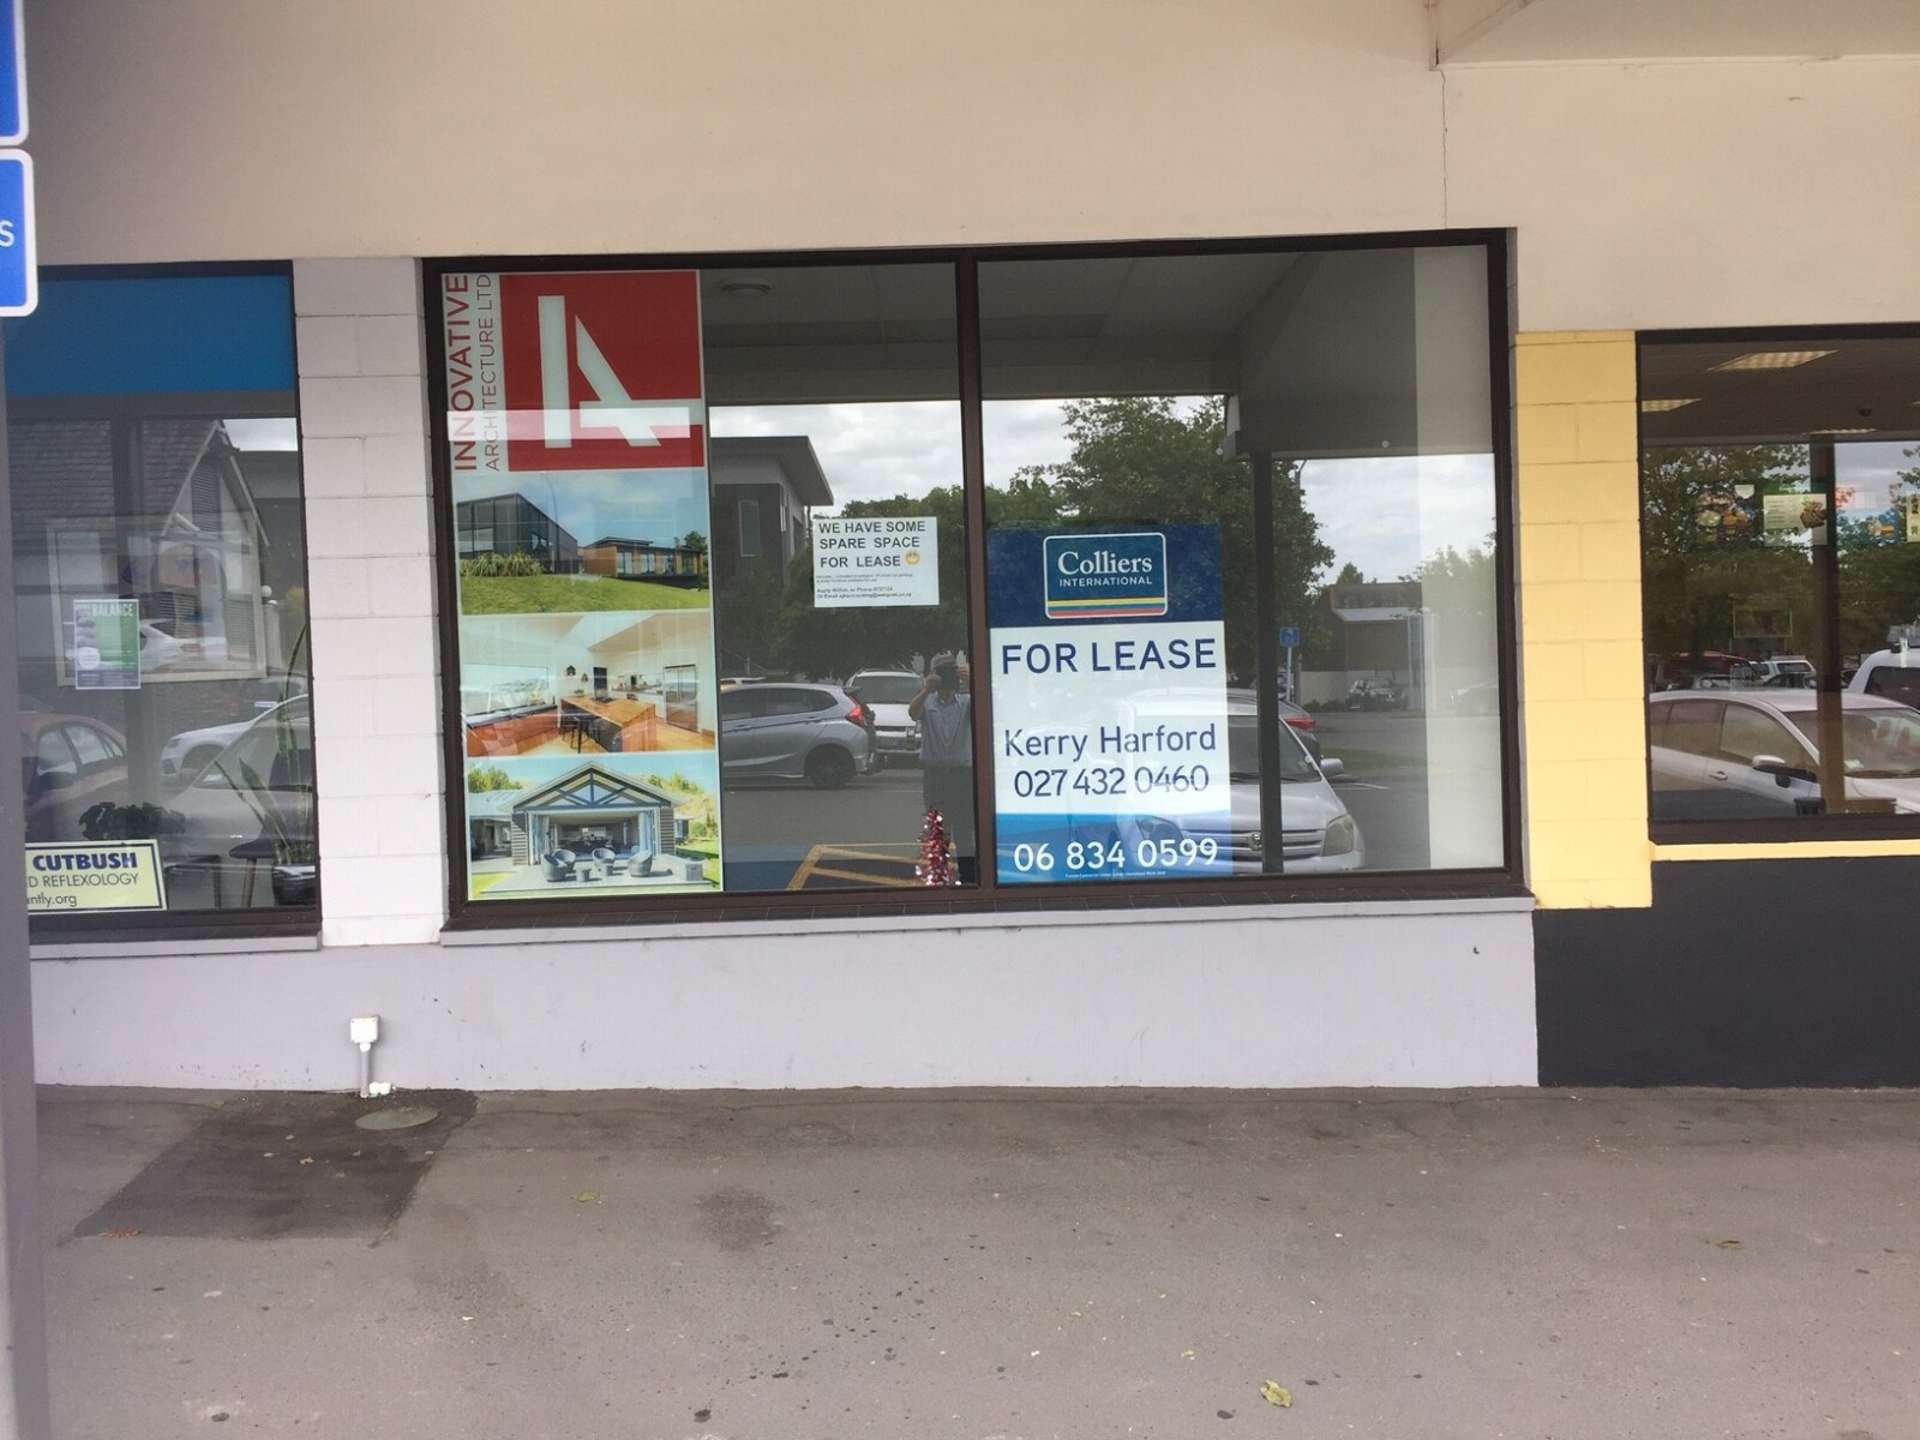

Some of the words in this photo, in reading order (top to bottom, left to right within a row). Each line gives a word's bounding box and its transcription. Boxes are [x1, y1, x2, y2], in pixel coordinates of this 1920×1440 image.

[476, 274, 493, 311] LTD
[445, 275, 477, 471] INNOVATIVE
[478, 317, 500, 472] ARCHITECTURE
[819, 522, 840, 534] WE
[845, 521, 882, 533] HAVE
[886, 520, 926, 532] SOME
[820, 538, 866, 549] SPARE
[874, 536, 920, 548] SPACE
[820, 557, 848, 568] FOR
[856, 555, 901, 567] LEASE
[1057, 550, 1152, 576] Colliers
[1059, 576, 1152, 587] INTERNATIONAL
[1002, 642, 1078, 674] FOR
[1092, 638, 1216, 672] LEASE
[1006, 729, 1088, 762] Kerry
[1100, 723, 1216, 753] Harford
[1014, 769, 1068, 798] 027
[1073, 767, 1127, 795] 432
[1134, 765, 1210, 793] 0460
[32, 852, 138, 871] CUTBUSH
[1014, 843, 1055, 872] 06
[1066, 841, 1126, 870] 834
[1137, 837, 1218, 868] 0599
[43, 872, 140, 888] REFLEXOLOGY
[28, 892, 78, 908] ntly.org
